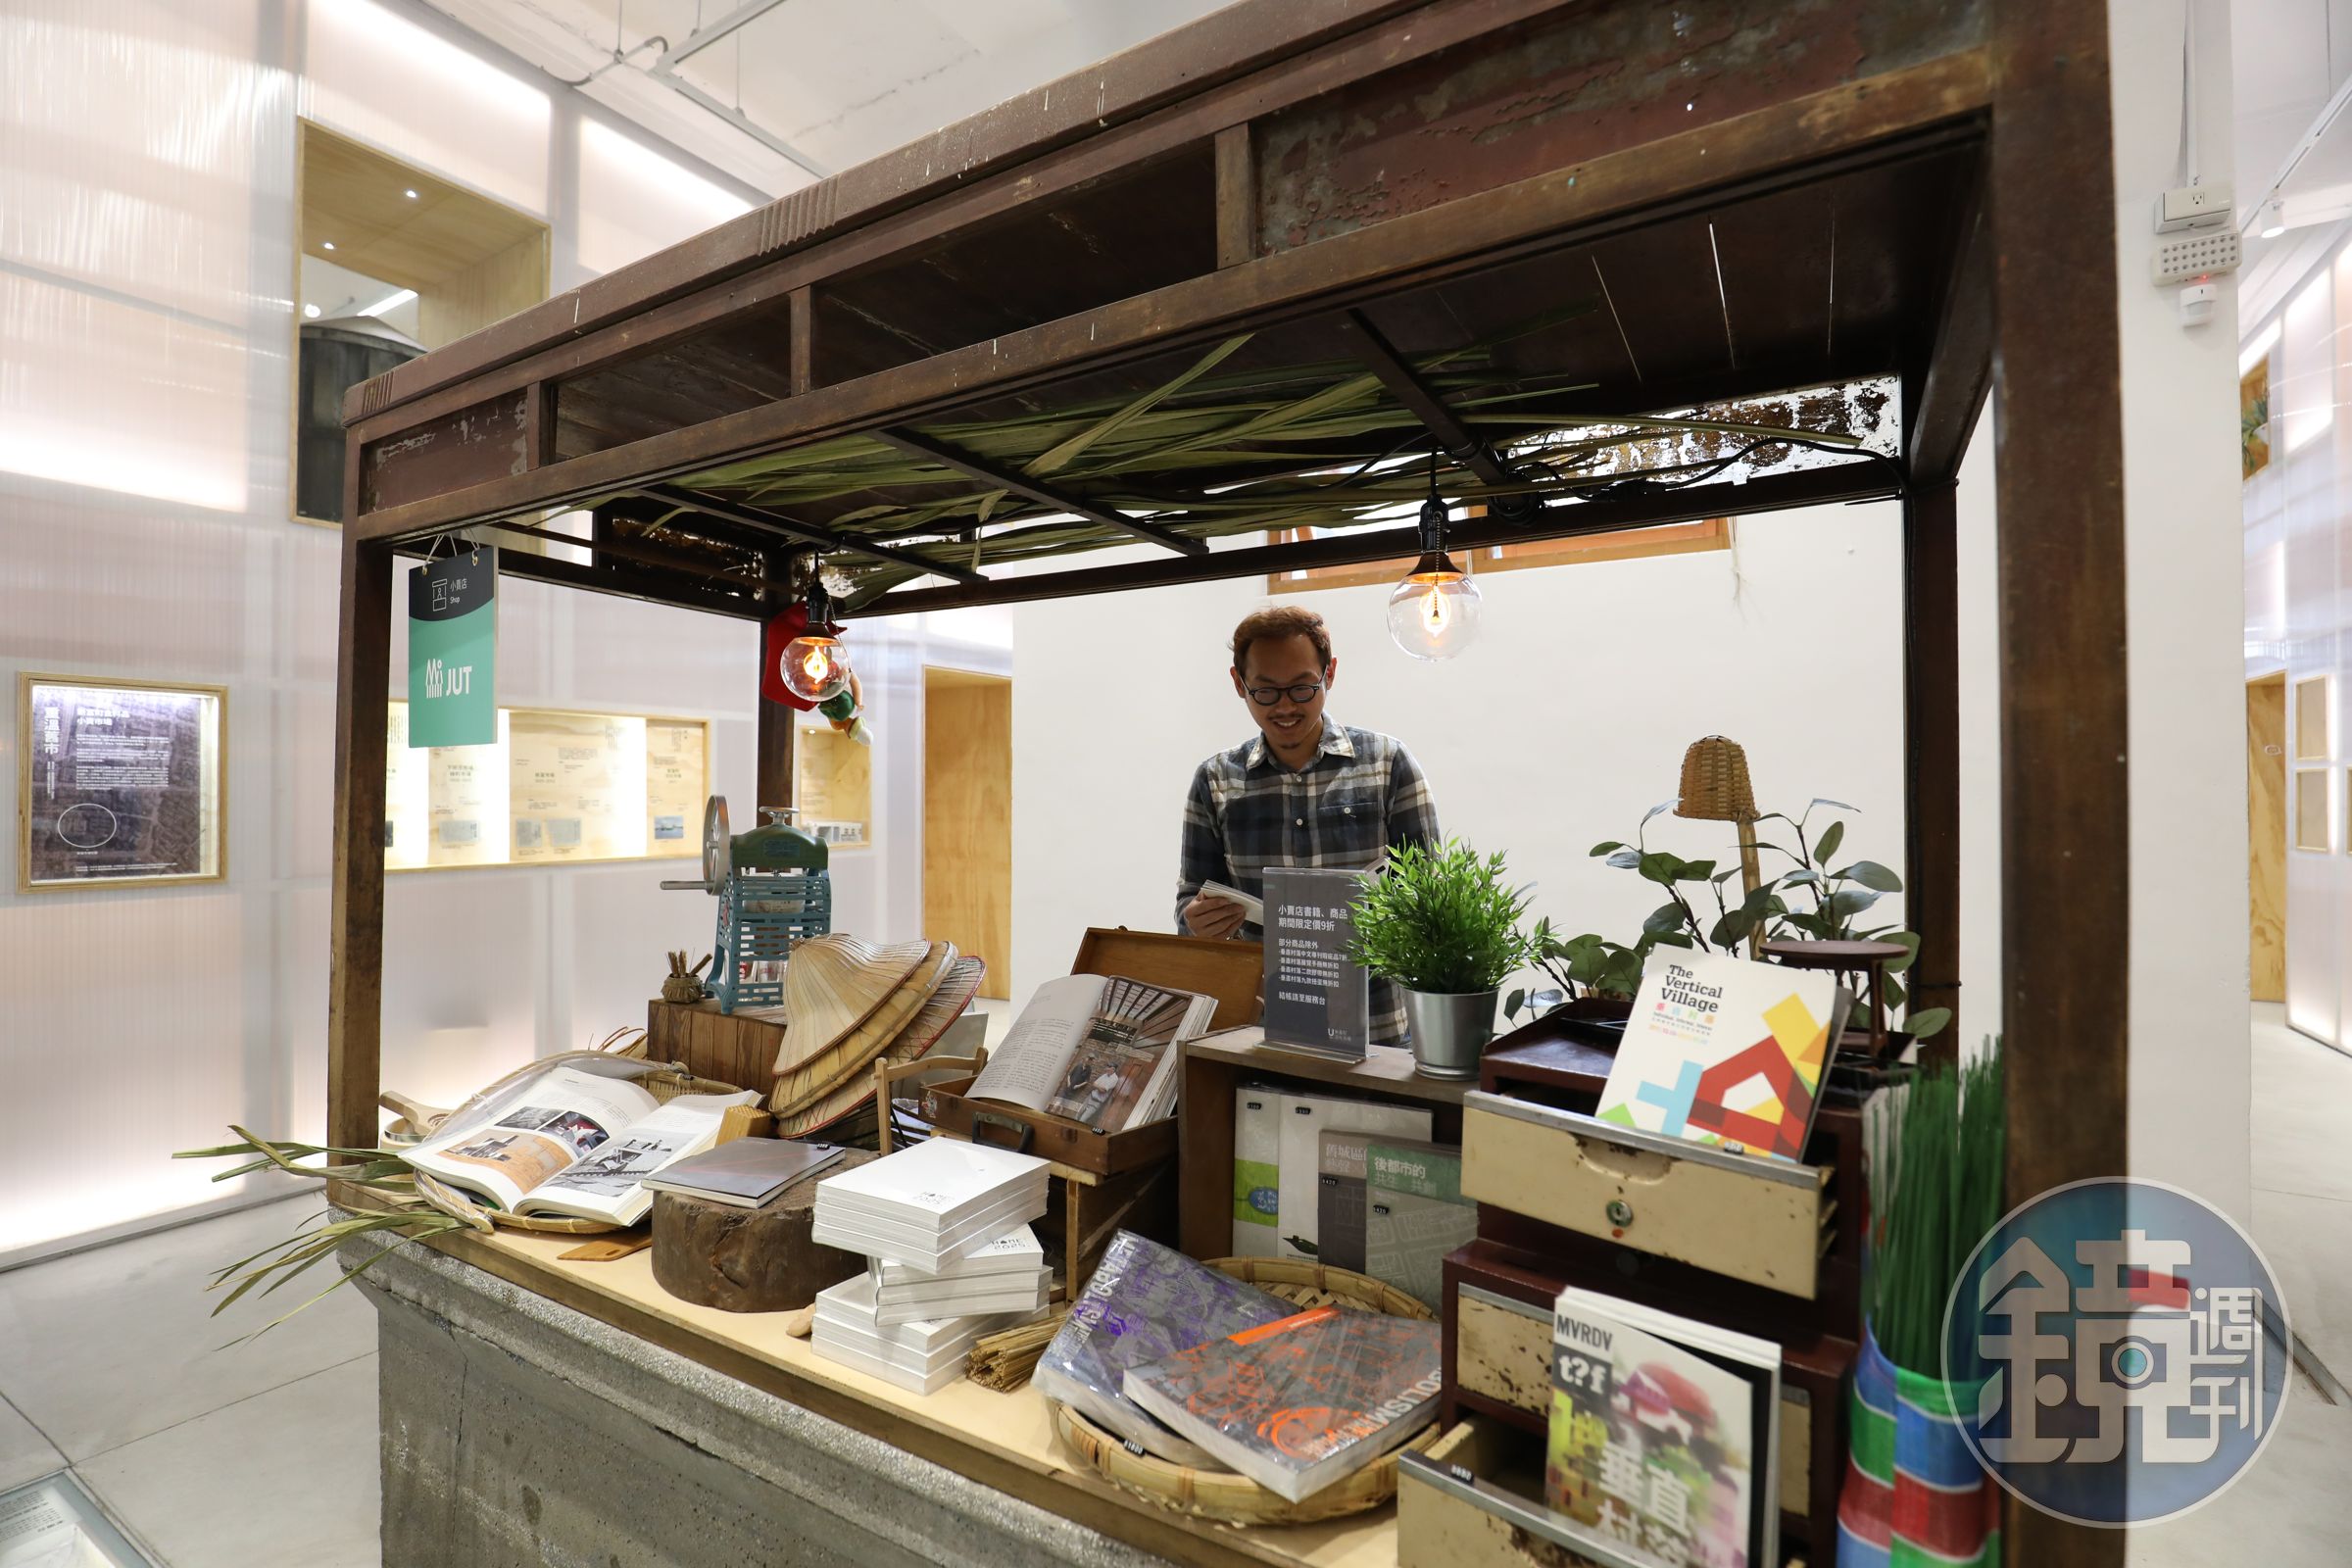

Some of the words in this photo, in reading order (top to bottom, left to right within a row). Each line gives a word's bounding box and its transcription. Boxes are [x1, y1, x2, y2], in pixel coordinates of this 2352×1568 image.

[450, 596, 461, 605] Shop
[446, 665, 472, 697] JUT
[1278, 916, 1336, 932] 期間限定價9折
[1669, 964, 1693, 979] The
[1665, 974, 1723, 999] Vertical
[1661, 987, 1719, 1012] Village
[1325, 1143, 1368, 1162] 舊城區
[1374, 1156, 1427, 1180] 後都市的
[1556, 1314, 1613, 1351] MVRDV
[1363, 1365, 1443, 1433] BOLISM
[1598, 1440, 1692, 1540] 垂直
